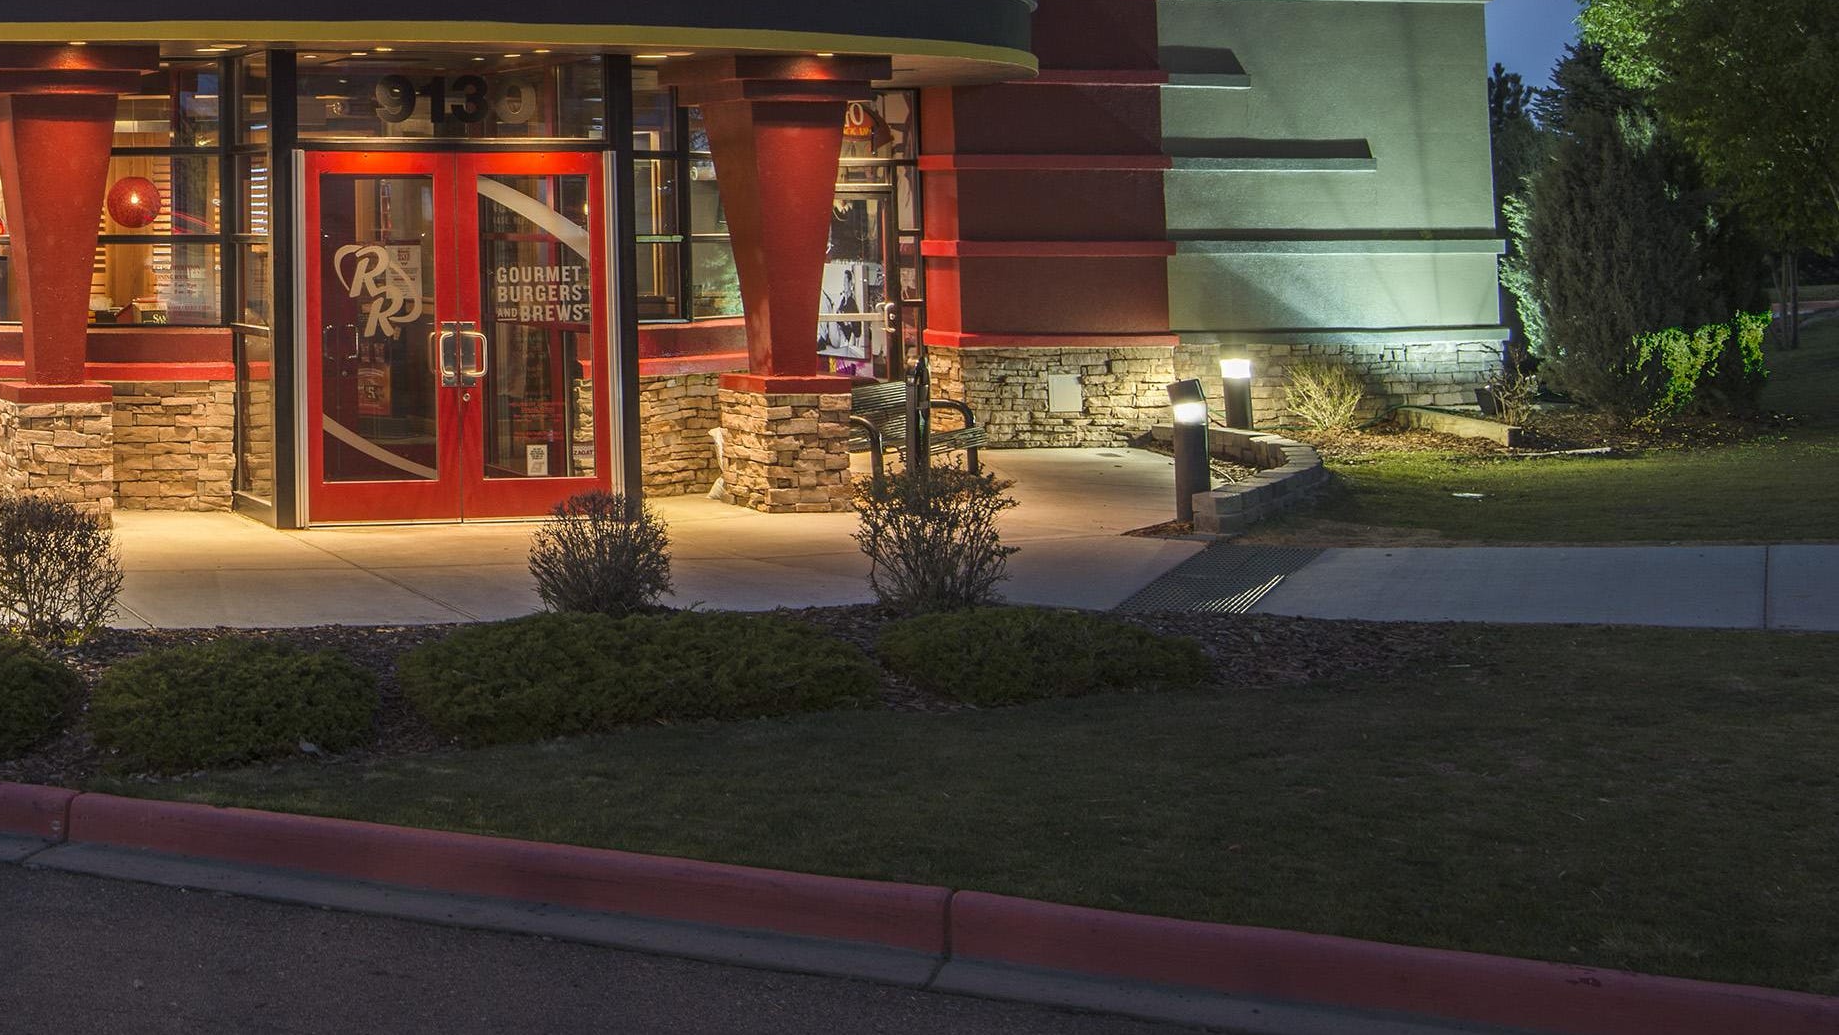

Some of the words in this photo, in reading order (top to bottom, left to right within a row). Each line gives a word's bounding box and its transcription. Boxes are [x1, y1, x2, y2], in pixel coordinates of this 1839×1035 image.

[496, 266, 581, 283] GOURMET
[497, 285, 582, 302] BURGERS
[496, 308, 518, 318] AND
[520, 304, 583, 322] BREWS
